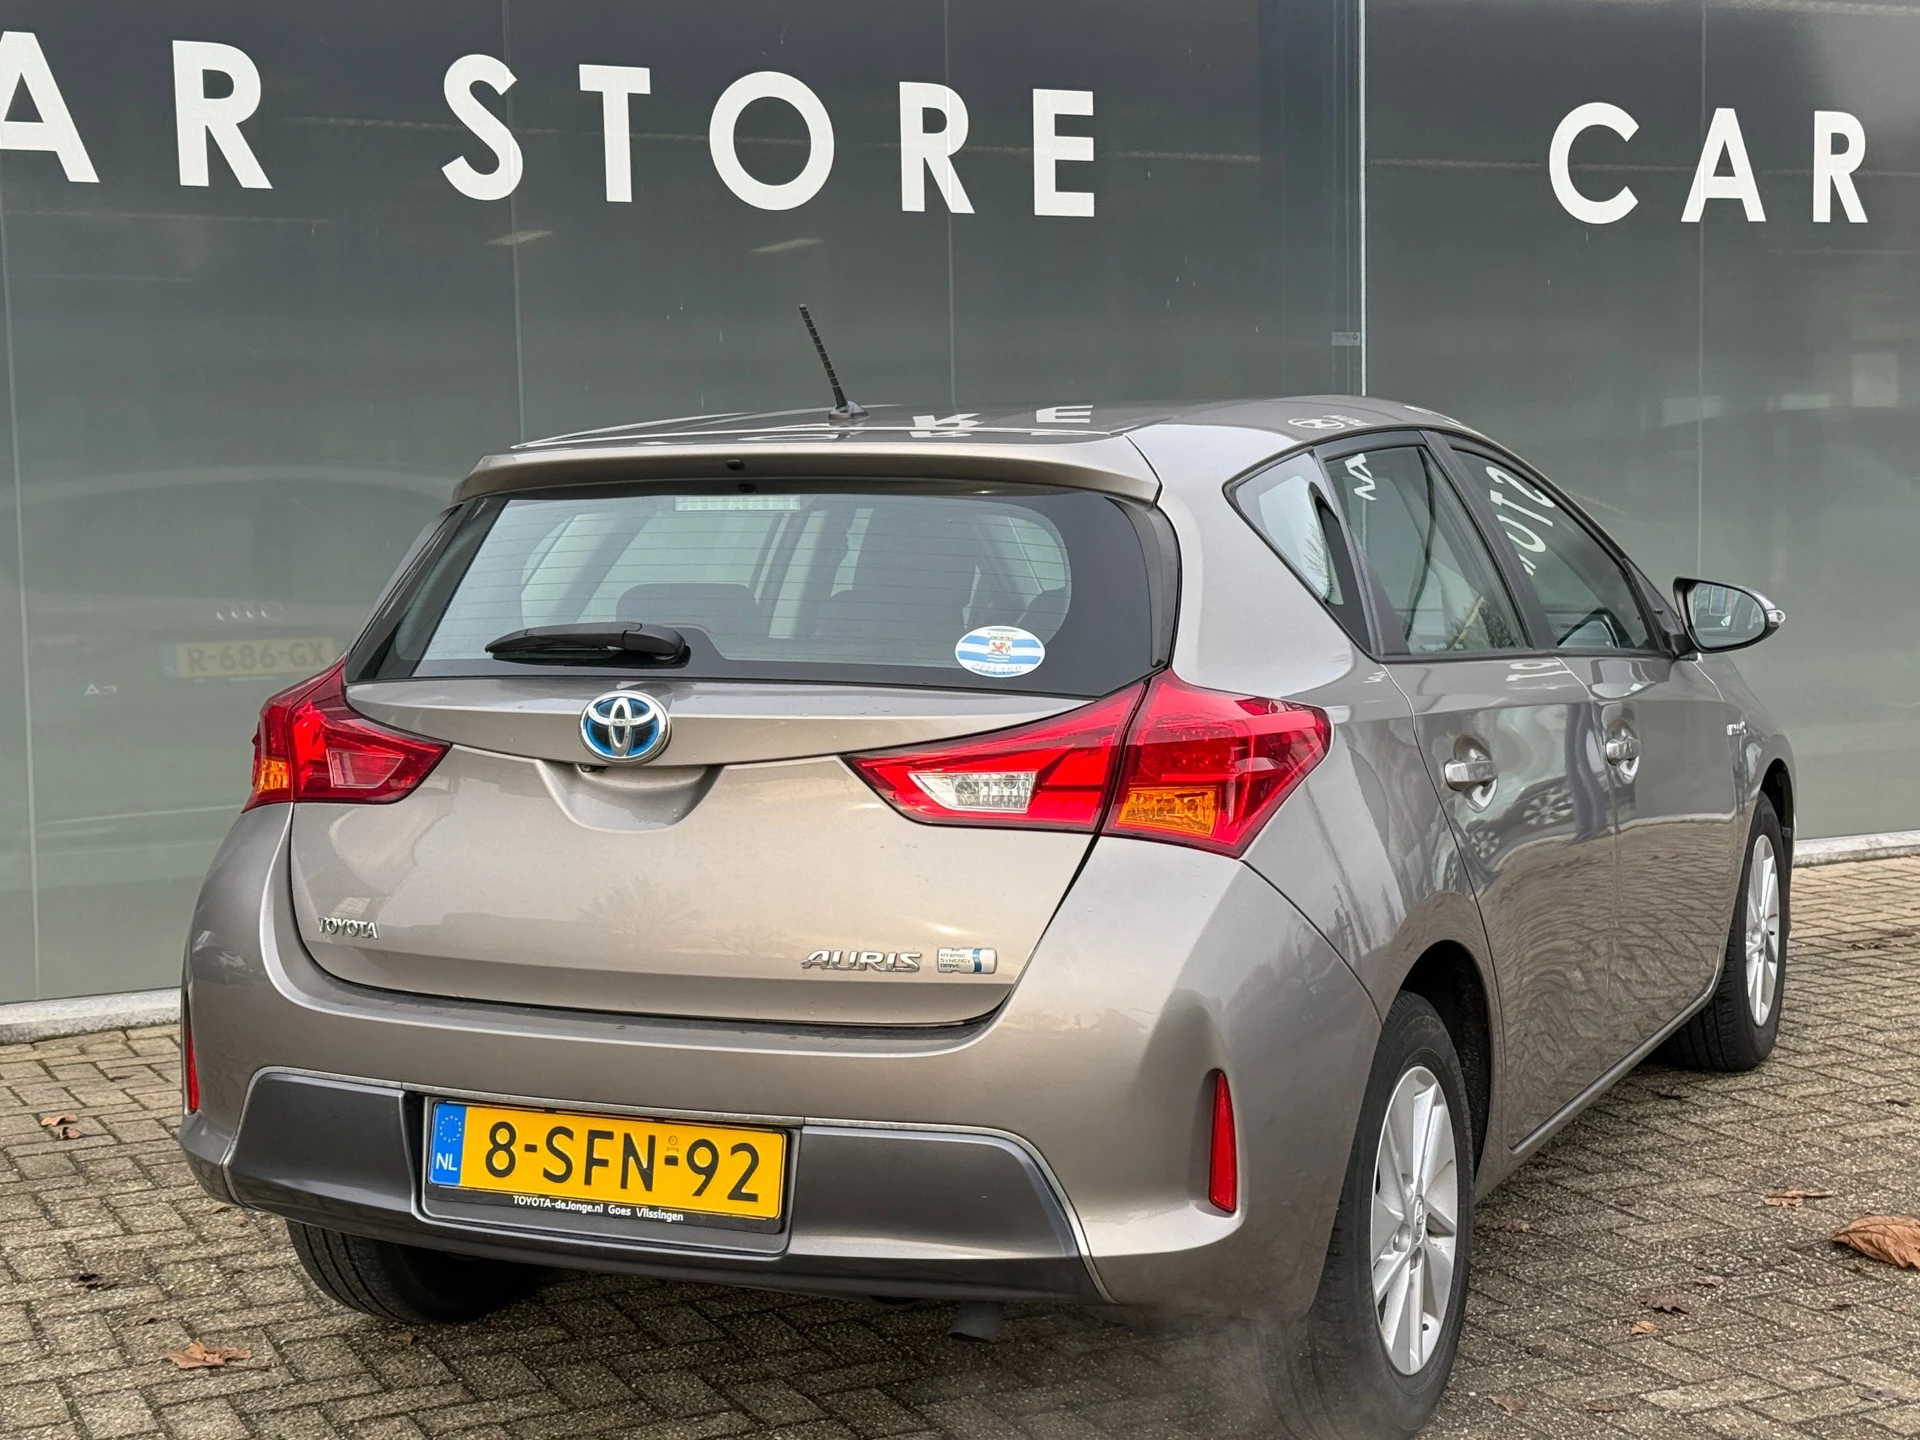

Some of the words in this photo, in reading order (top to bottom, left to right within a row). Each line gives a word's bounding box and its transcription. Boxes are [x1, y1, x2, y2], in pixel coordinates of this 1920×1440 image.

[441, 53, 1095, 218] STORE
[1548, 102, 1868, 224] CAR
[318, 916, 379, 940] TOYOTA
[802, 949, 922, 973] AURIS
[435, 1152, 458, 1171] NL
[485, 1120, 759, 1203] 8-SFN-92
[608, 1204, 632, 1216] Goes
[636, 1207, 684, 1222] Vlissingen
